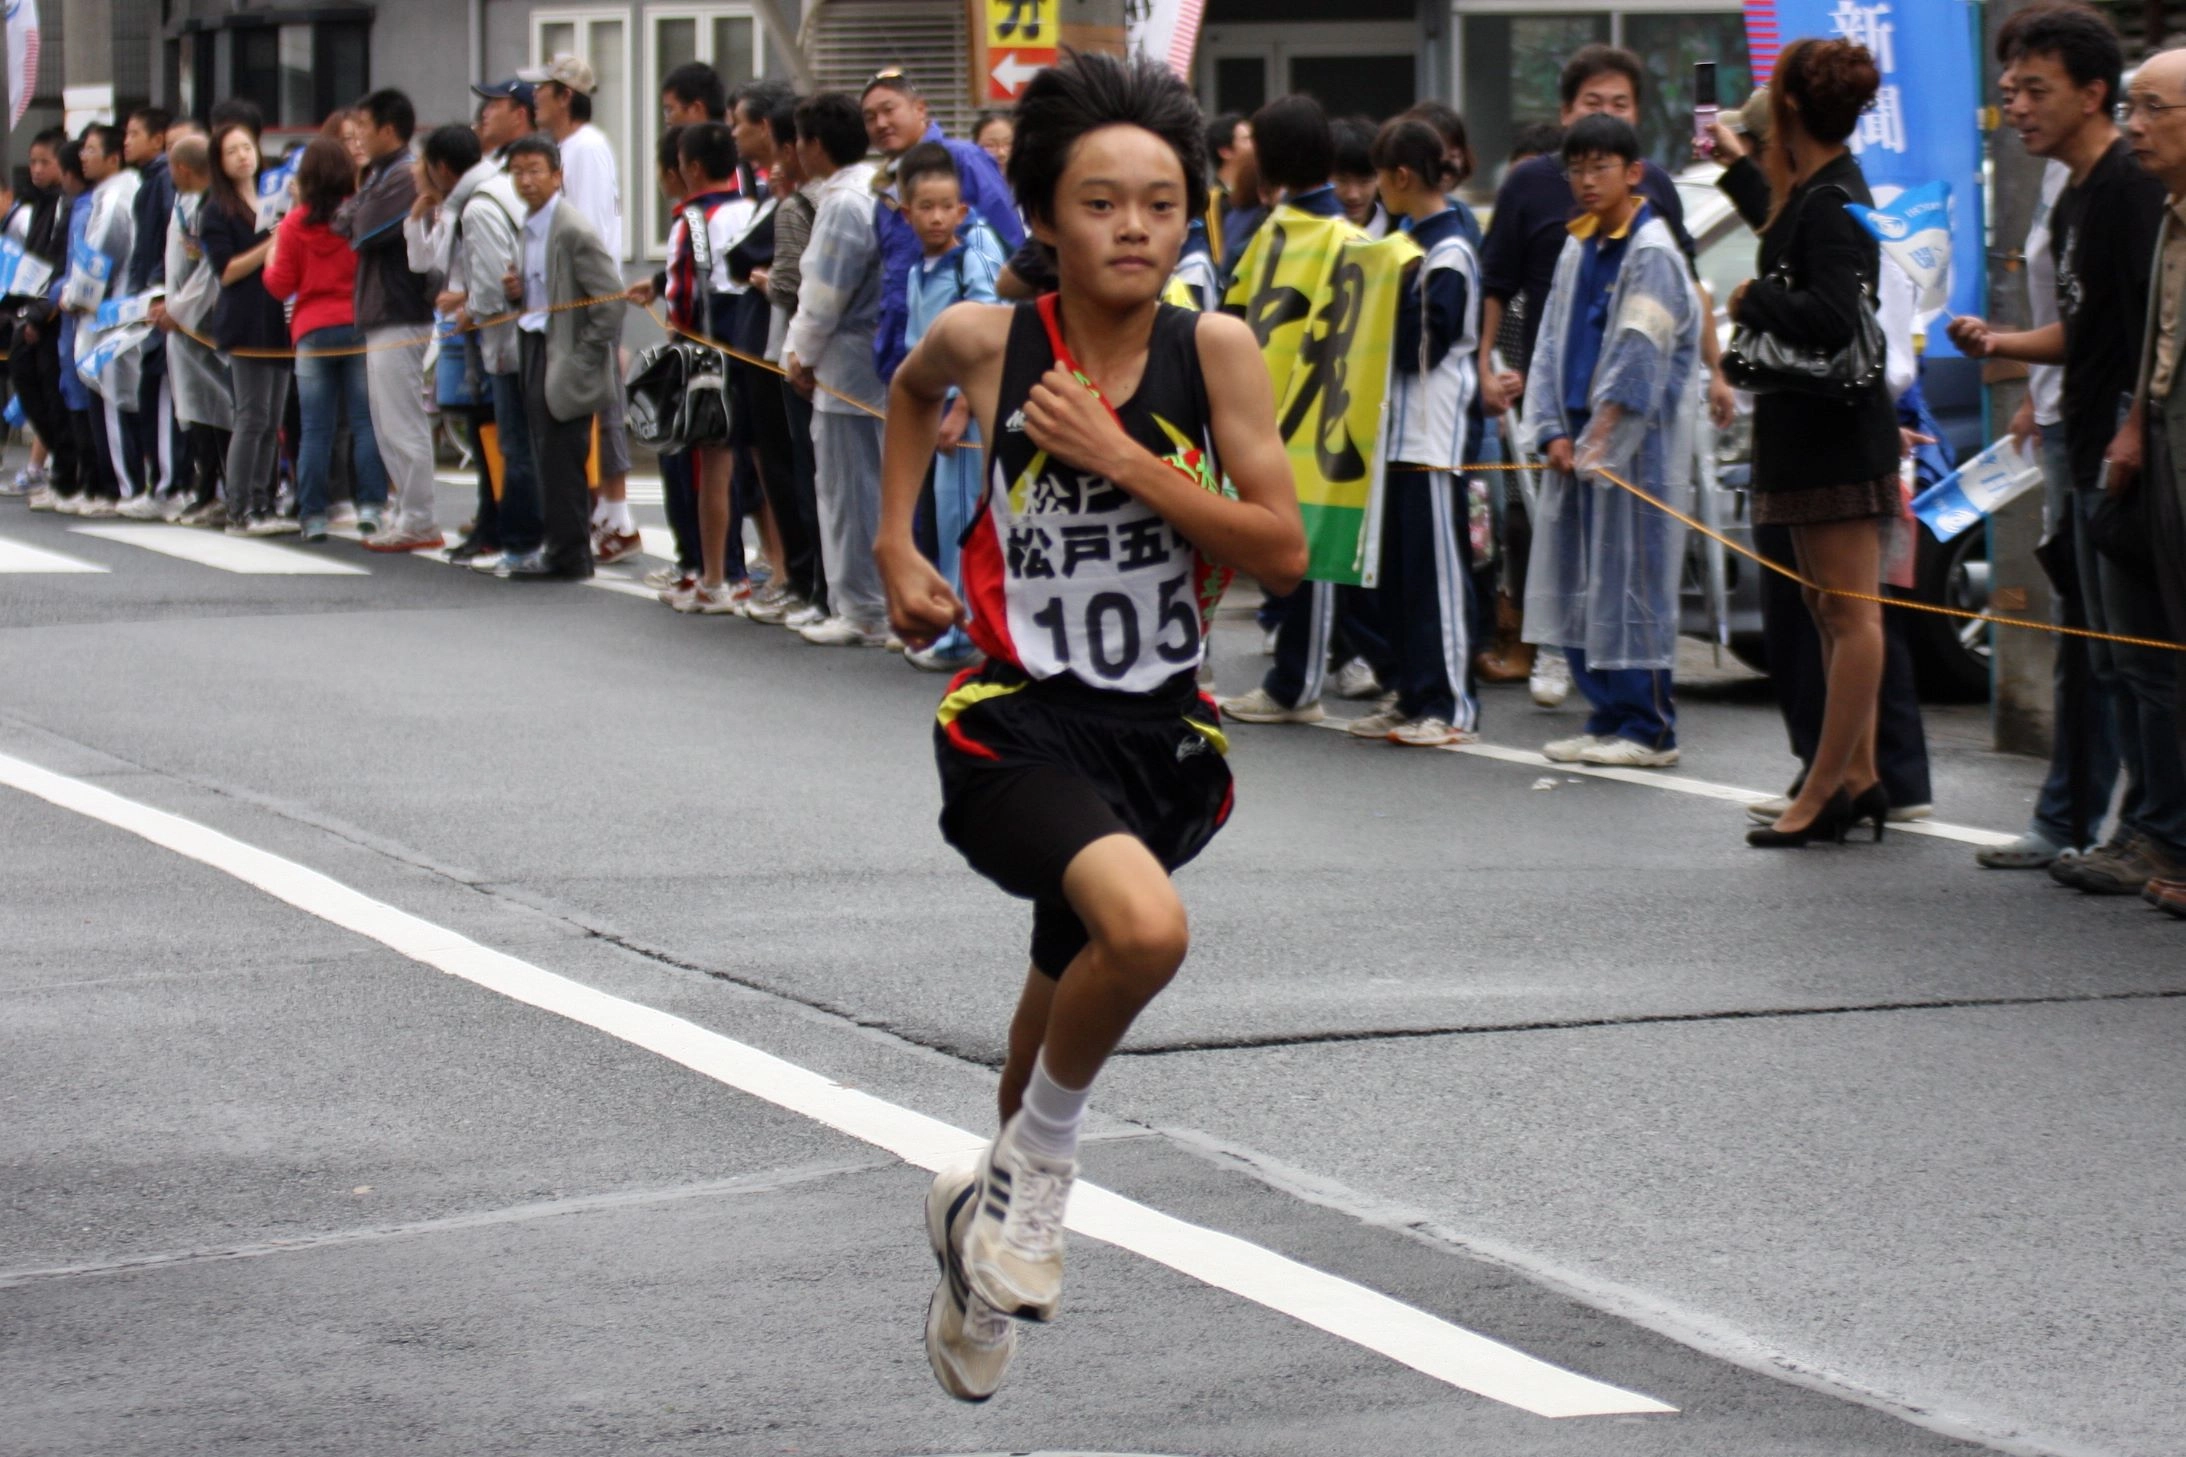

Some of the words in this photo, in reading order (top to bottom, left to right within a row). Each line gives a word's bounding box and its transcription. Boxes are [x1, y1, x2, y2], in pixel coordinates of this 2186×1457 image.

[1007, 517, 1193, 580] 松戸五
[1033, 573, 1201, 680] 105
